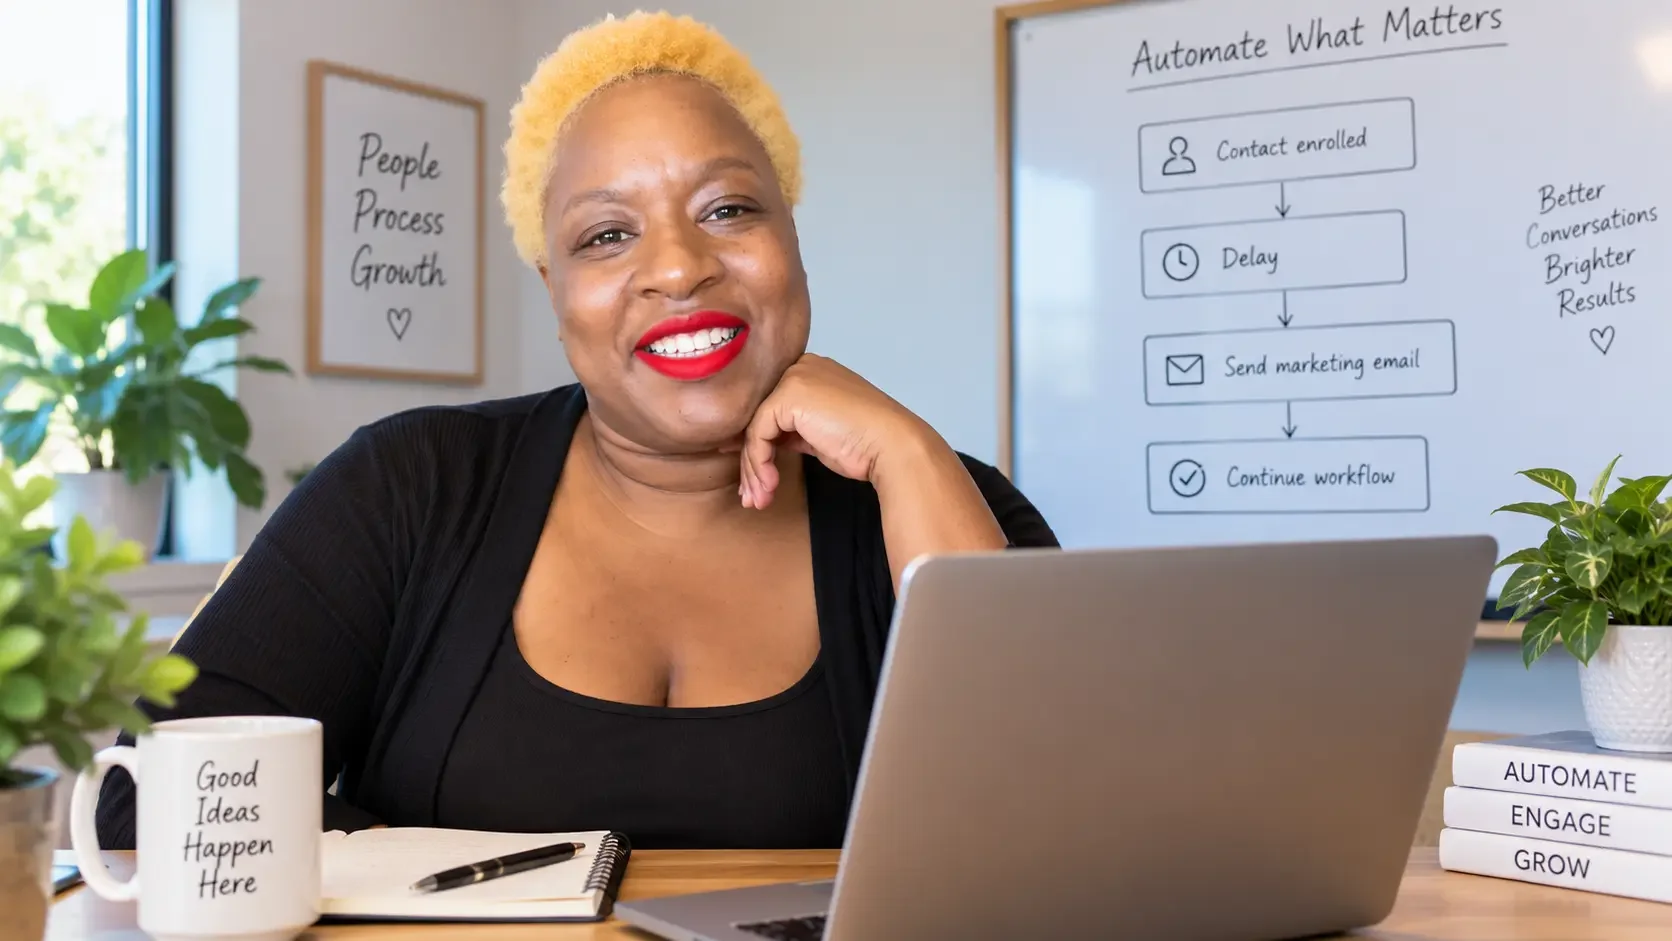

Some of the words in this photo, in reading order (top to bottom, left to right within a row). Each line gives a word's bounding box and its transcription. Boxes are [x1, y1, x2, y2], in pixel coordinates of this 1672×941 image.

[1131, 31, 1268, 77] Automate
[1288, 17, 1364, 54] What
[1383, 5, 1502, 42] Matters
[1217, 137, 1288, 161] Contact
[1297, 126, 1367, 153] enrolled
[358, 132, 441, 192] People
[354, 188, 444, 235] Process
[1539, 182, 1605, 214] Better
[1526, 204, 1658, 249] Conversations
[351, 244, 446, 291] Growth
[1222, 245, 1278, 274] Delay
[1545, 247, 1635, 285] Brighter
[1557, 281, 1635, 318] Results
[1225, 355, 1267, 377] Send
[1276, 352, 1364, 380] marketing
[1373, 348, 1419, 370] email
[1227, 465, 1306, 488] Continue
[1315, 464, 1395, 485] workflow
[197, 760, 257, 790] Good
[1504, 761, 1636, 793] AUTOMATE
[195, 796, 260, 826] Ideas
[1512, 805, 1610, 836] ENGAGE
[184, 831, 273, 870] Happen
[1515, 849, 1590, 878] GROW
[199, 868, 257, 899] Here
